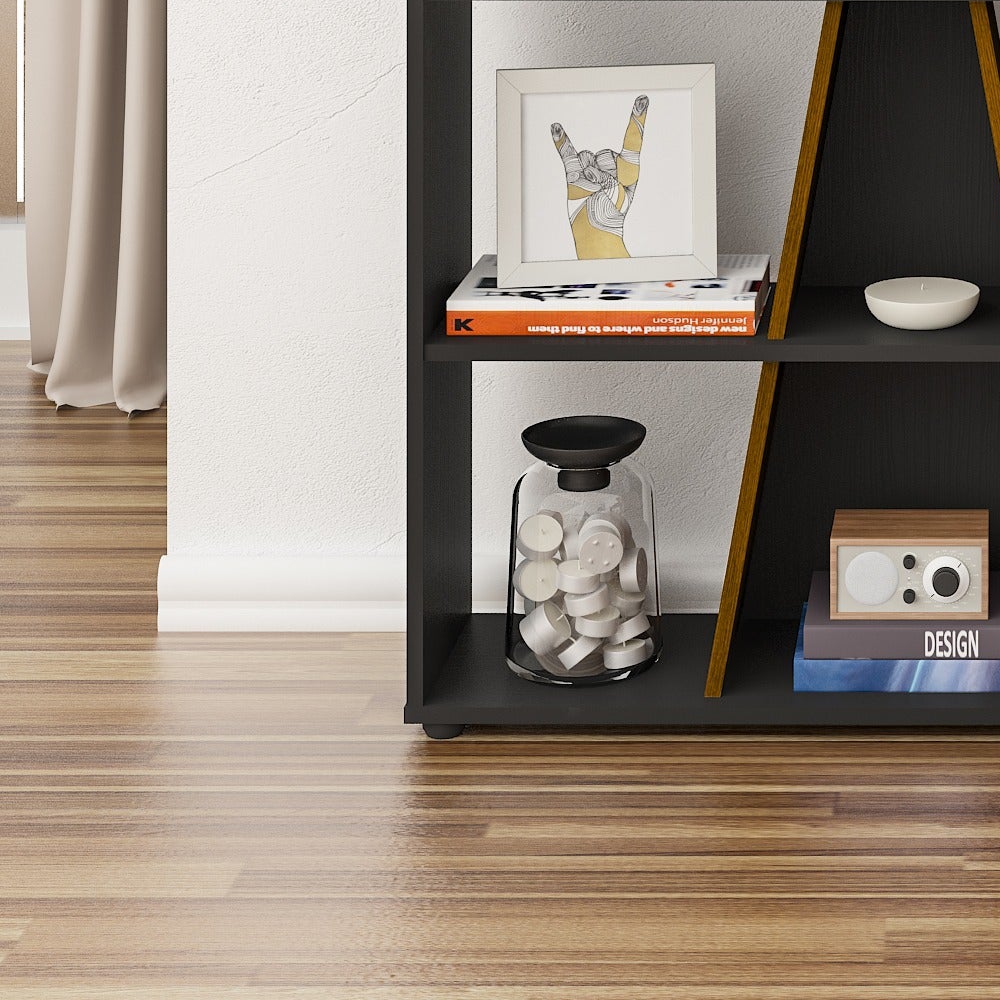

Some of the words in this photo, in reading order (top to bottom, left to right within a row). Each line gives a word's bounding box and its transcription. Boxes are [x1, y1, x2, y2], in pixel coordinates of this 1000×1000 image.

[454, 318, 475, 331] K
[652, 317, 699, 325] Hudson
[701, 317, 747, 325] Jennifer
[527, 325, 561, 334] them
[562, 325, 586, 334] find
[587, 325, 601, 334] to
[602, 325, 643, 334] where
[643, 325, 667, 334] and
[668, 324, 719, 334] designs
[720, 325, 747, 333] new
[924, 630, 979, 658] DESIGN
